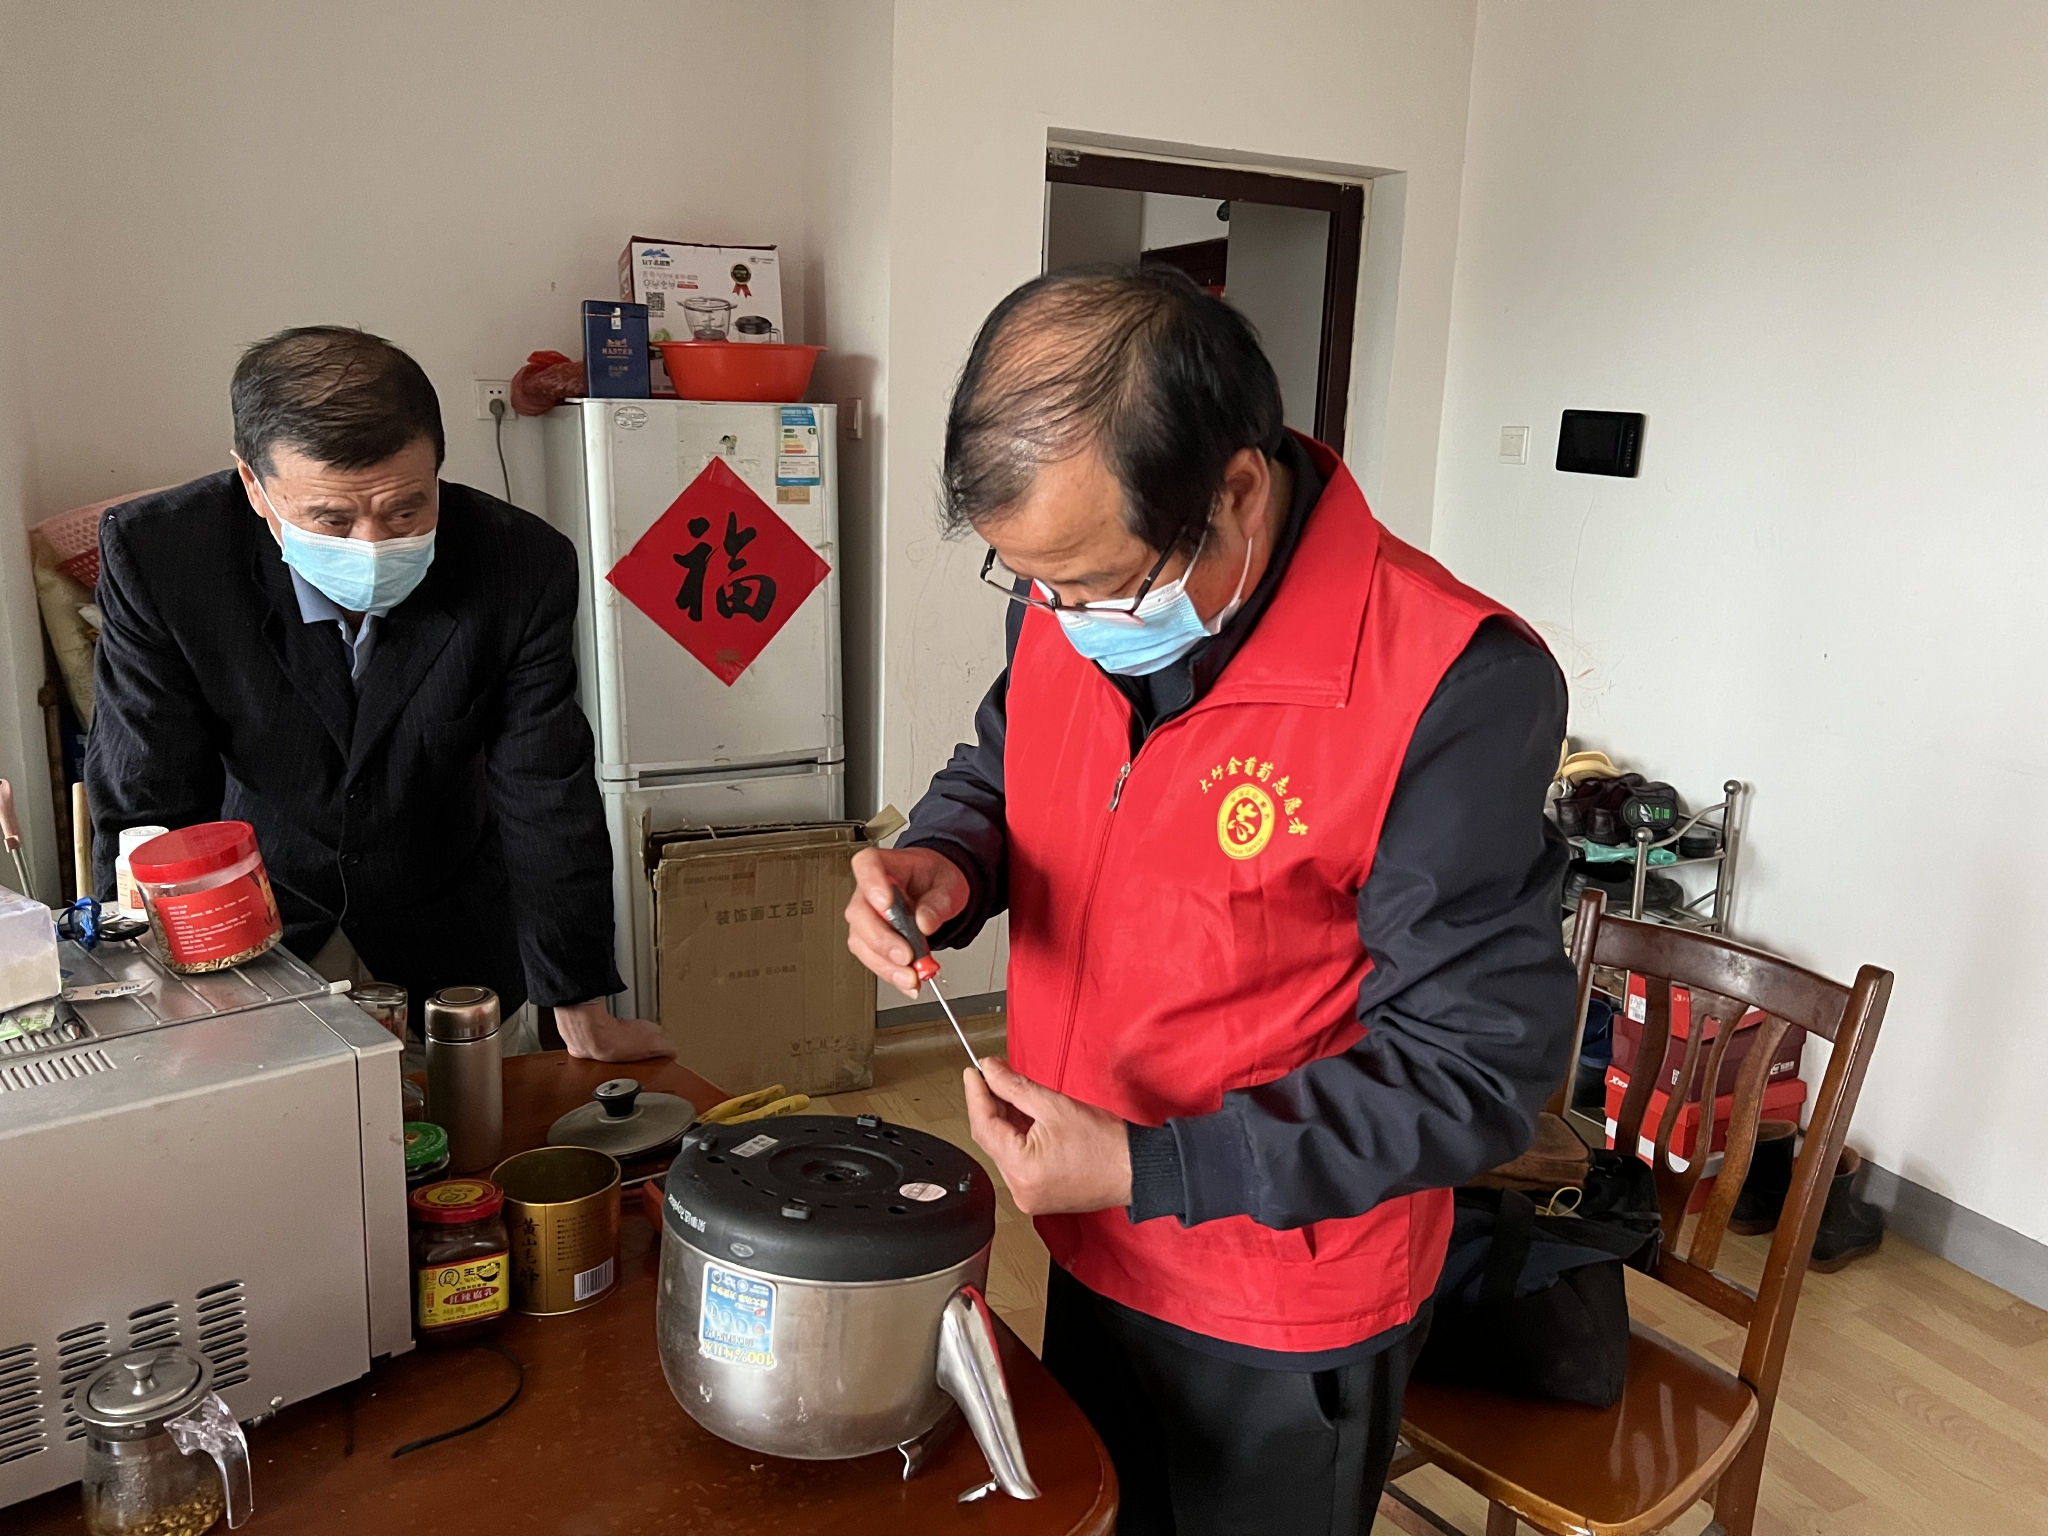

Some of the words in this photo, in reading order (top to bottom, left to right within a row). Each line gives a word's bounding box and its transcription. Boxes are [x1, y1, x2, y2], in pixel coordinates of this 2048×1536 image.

[602, 347, 633, 356] MASTER
[673, 511, 777, 623] 福
[715, 900, 814, 925] 装饰画工艺品
[519, 1217, 541, 1297] 黄山毛峰
[448, 1287, 495, 1306] 红辣腐乳
